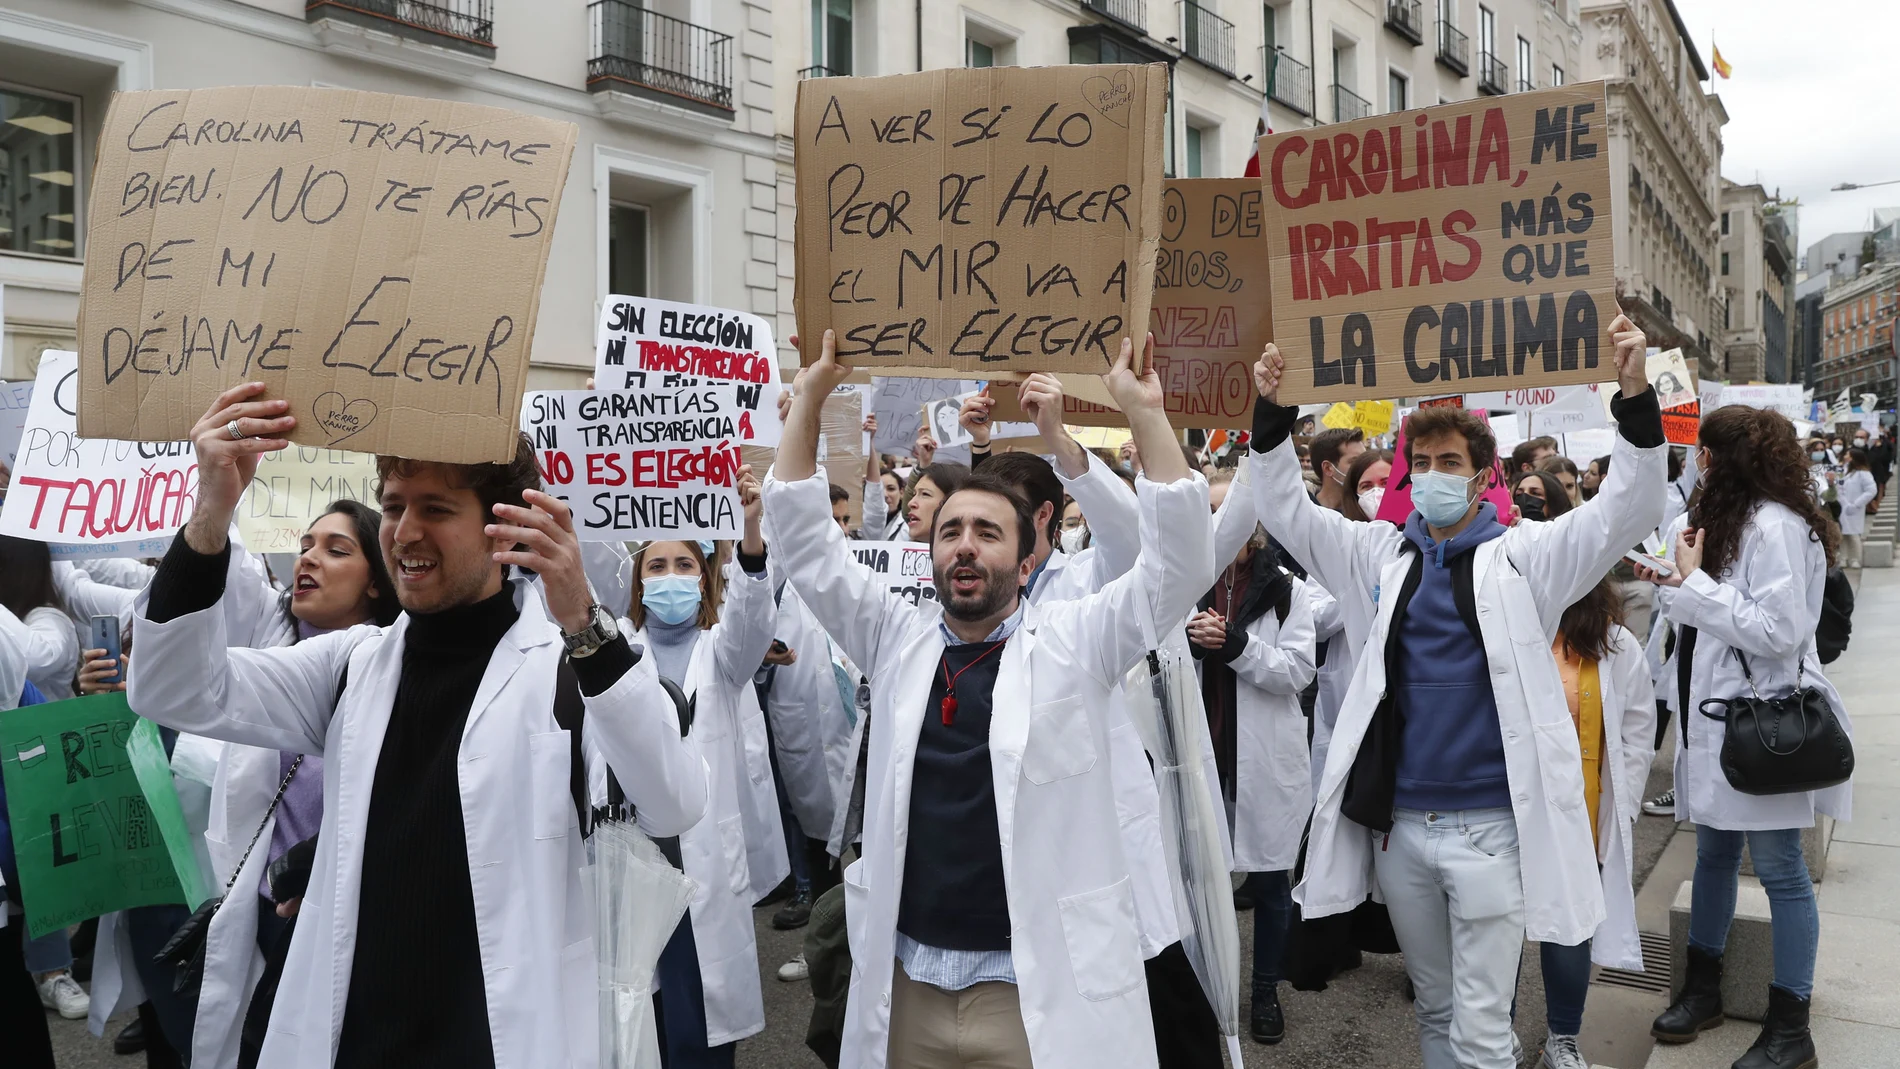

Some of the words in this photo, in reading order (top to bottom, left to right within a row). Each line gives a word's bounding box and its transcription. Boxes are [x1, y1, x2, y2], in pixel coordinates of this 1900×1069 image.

[1099, 84, 1127, 103] PERRO
[128, 101, 304, 151] CAROLINA
[340, 118, 551, 165] TRÁTAME
[815, 95, 850, 145] A
[870, 109, 935, 144] VER
[1025, 102, 1092, 148] LO
[1530, 102, 1597, 165] ME
[119, 168, 222, 217] BIEN.
[242, 165, 349, 224] NO
[375, 179, 433, 213] TE
[447, 180, 549, 238] RÍAS
[828, 163, 912, 252] PEOR
[939, 173, 985, 224] DE
[996, 165, 1132, 232] HACER
[1162, 187, 1186, 242] O
[1211, 190, 1262, 238] DE
[113, 239, 195, 292] DE
[217, 247, 276, 287] MI
[1287, 209, 1482, 301] IRRITAS
[1500, 181, 1594, 239] MÁS
[1502, 240, 1590, 285] QUE
[828, 268, 876, 304] EL
[898, 240, 1000, 310] MIR
[1026, 262, 1082, 298] VA
[1102, 260, 1127, 302] A
[1154, 247, 1243, 293] RIOS,
[103, 311, 302, 386] DÉJAME
[323, 276, 513, 416] ELEGIR
[835, 317, 934, 356] SER
[949, 309, 1123, 367] ELEGIR
[1151, 305, 1239, 348] NZA
[1309, 312, 1377, 388] LA
[1403, 290, 1599, 384] CALIMA
[329, 410, 359, 425] PERRO
[531, 394, 566, 425] SIN
[578, 389, 720, 421] GARANTÍAS
[1505, 389, 1556, 406] FOUND
[26, 427, 80, 468] POR
[536, 425, 557, 449] NI
[577, 416, 735, 447] TRANSPARENCIA
[586, 453, 627, 486] ES
[632, 440, 741, 488] ELECCIÓN
[251, 476, 298, 518] DEL
[584, 492, 735, 530] SENTENCIA
